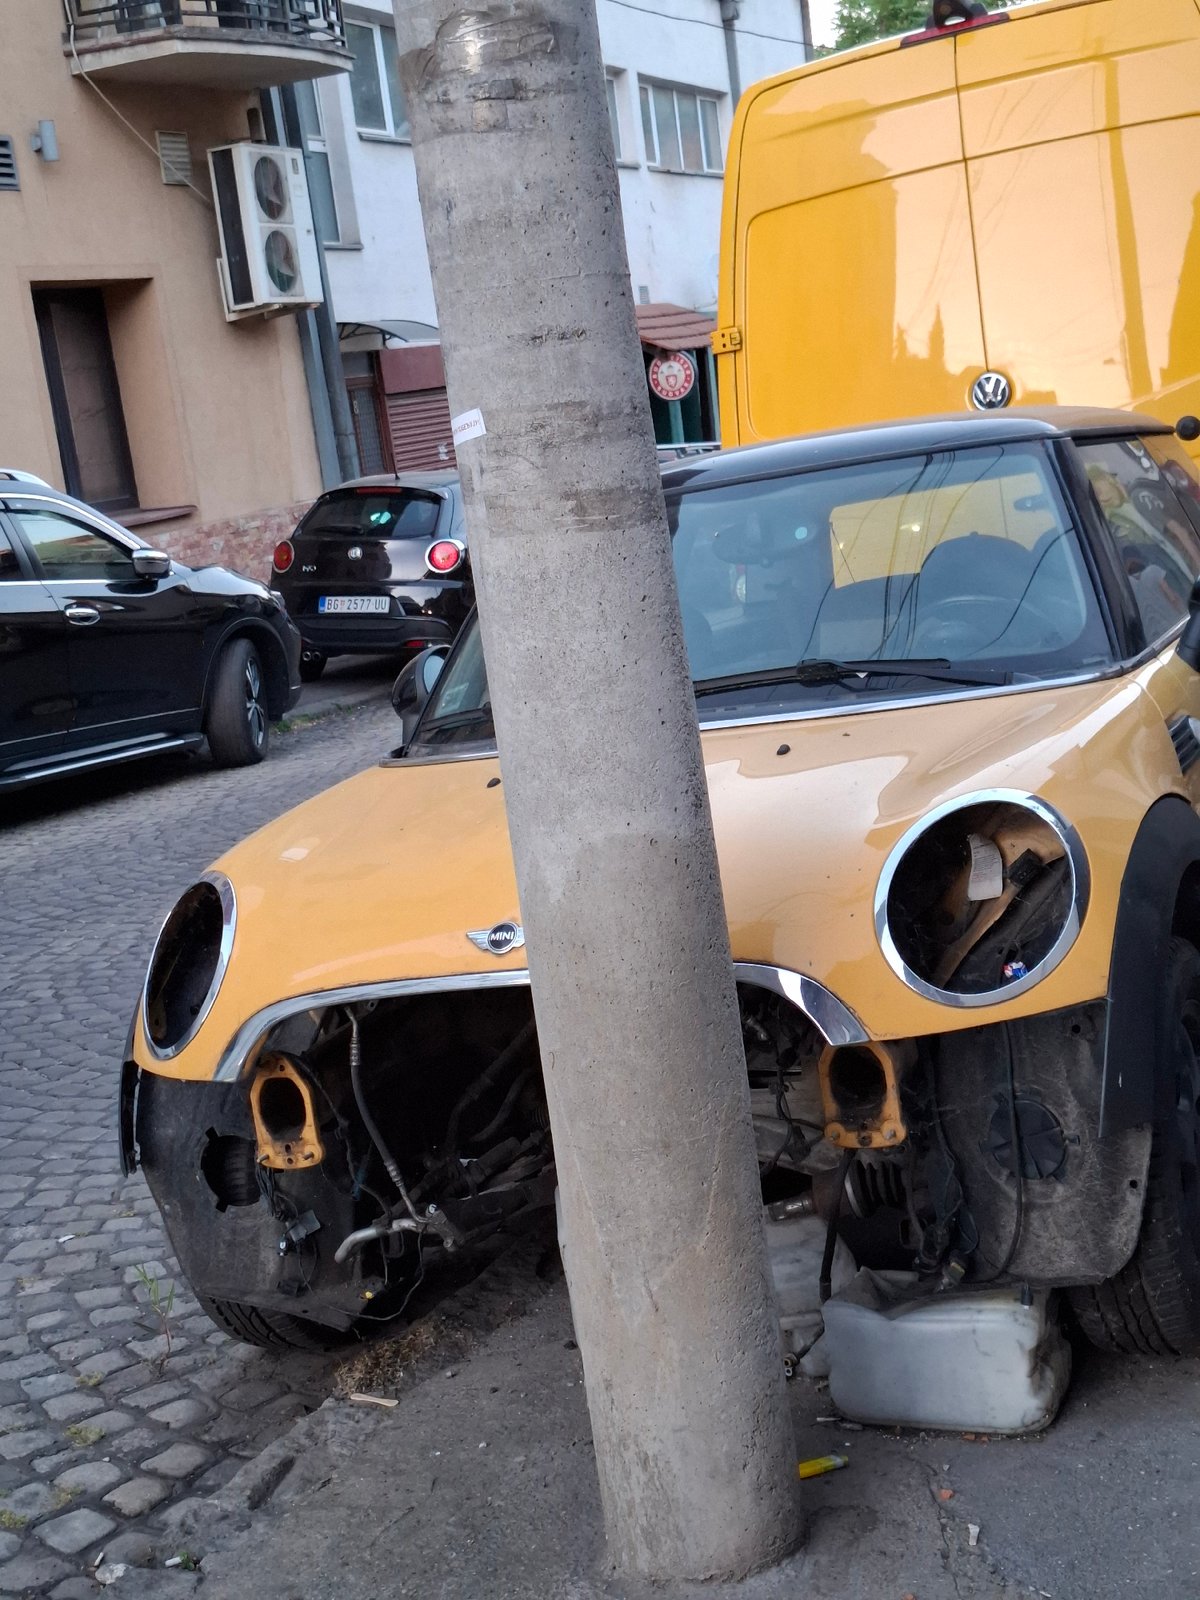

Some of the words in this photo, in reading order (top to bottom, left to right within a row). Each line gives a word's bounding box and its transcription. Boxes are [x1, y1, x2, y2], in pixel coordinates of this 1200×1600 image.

[327, 599, 339, 611] BG
[374, 599, 387, 611] UU
[490, 931, 514, 941] MINI
